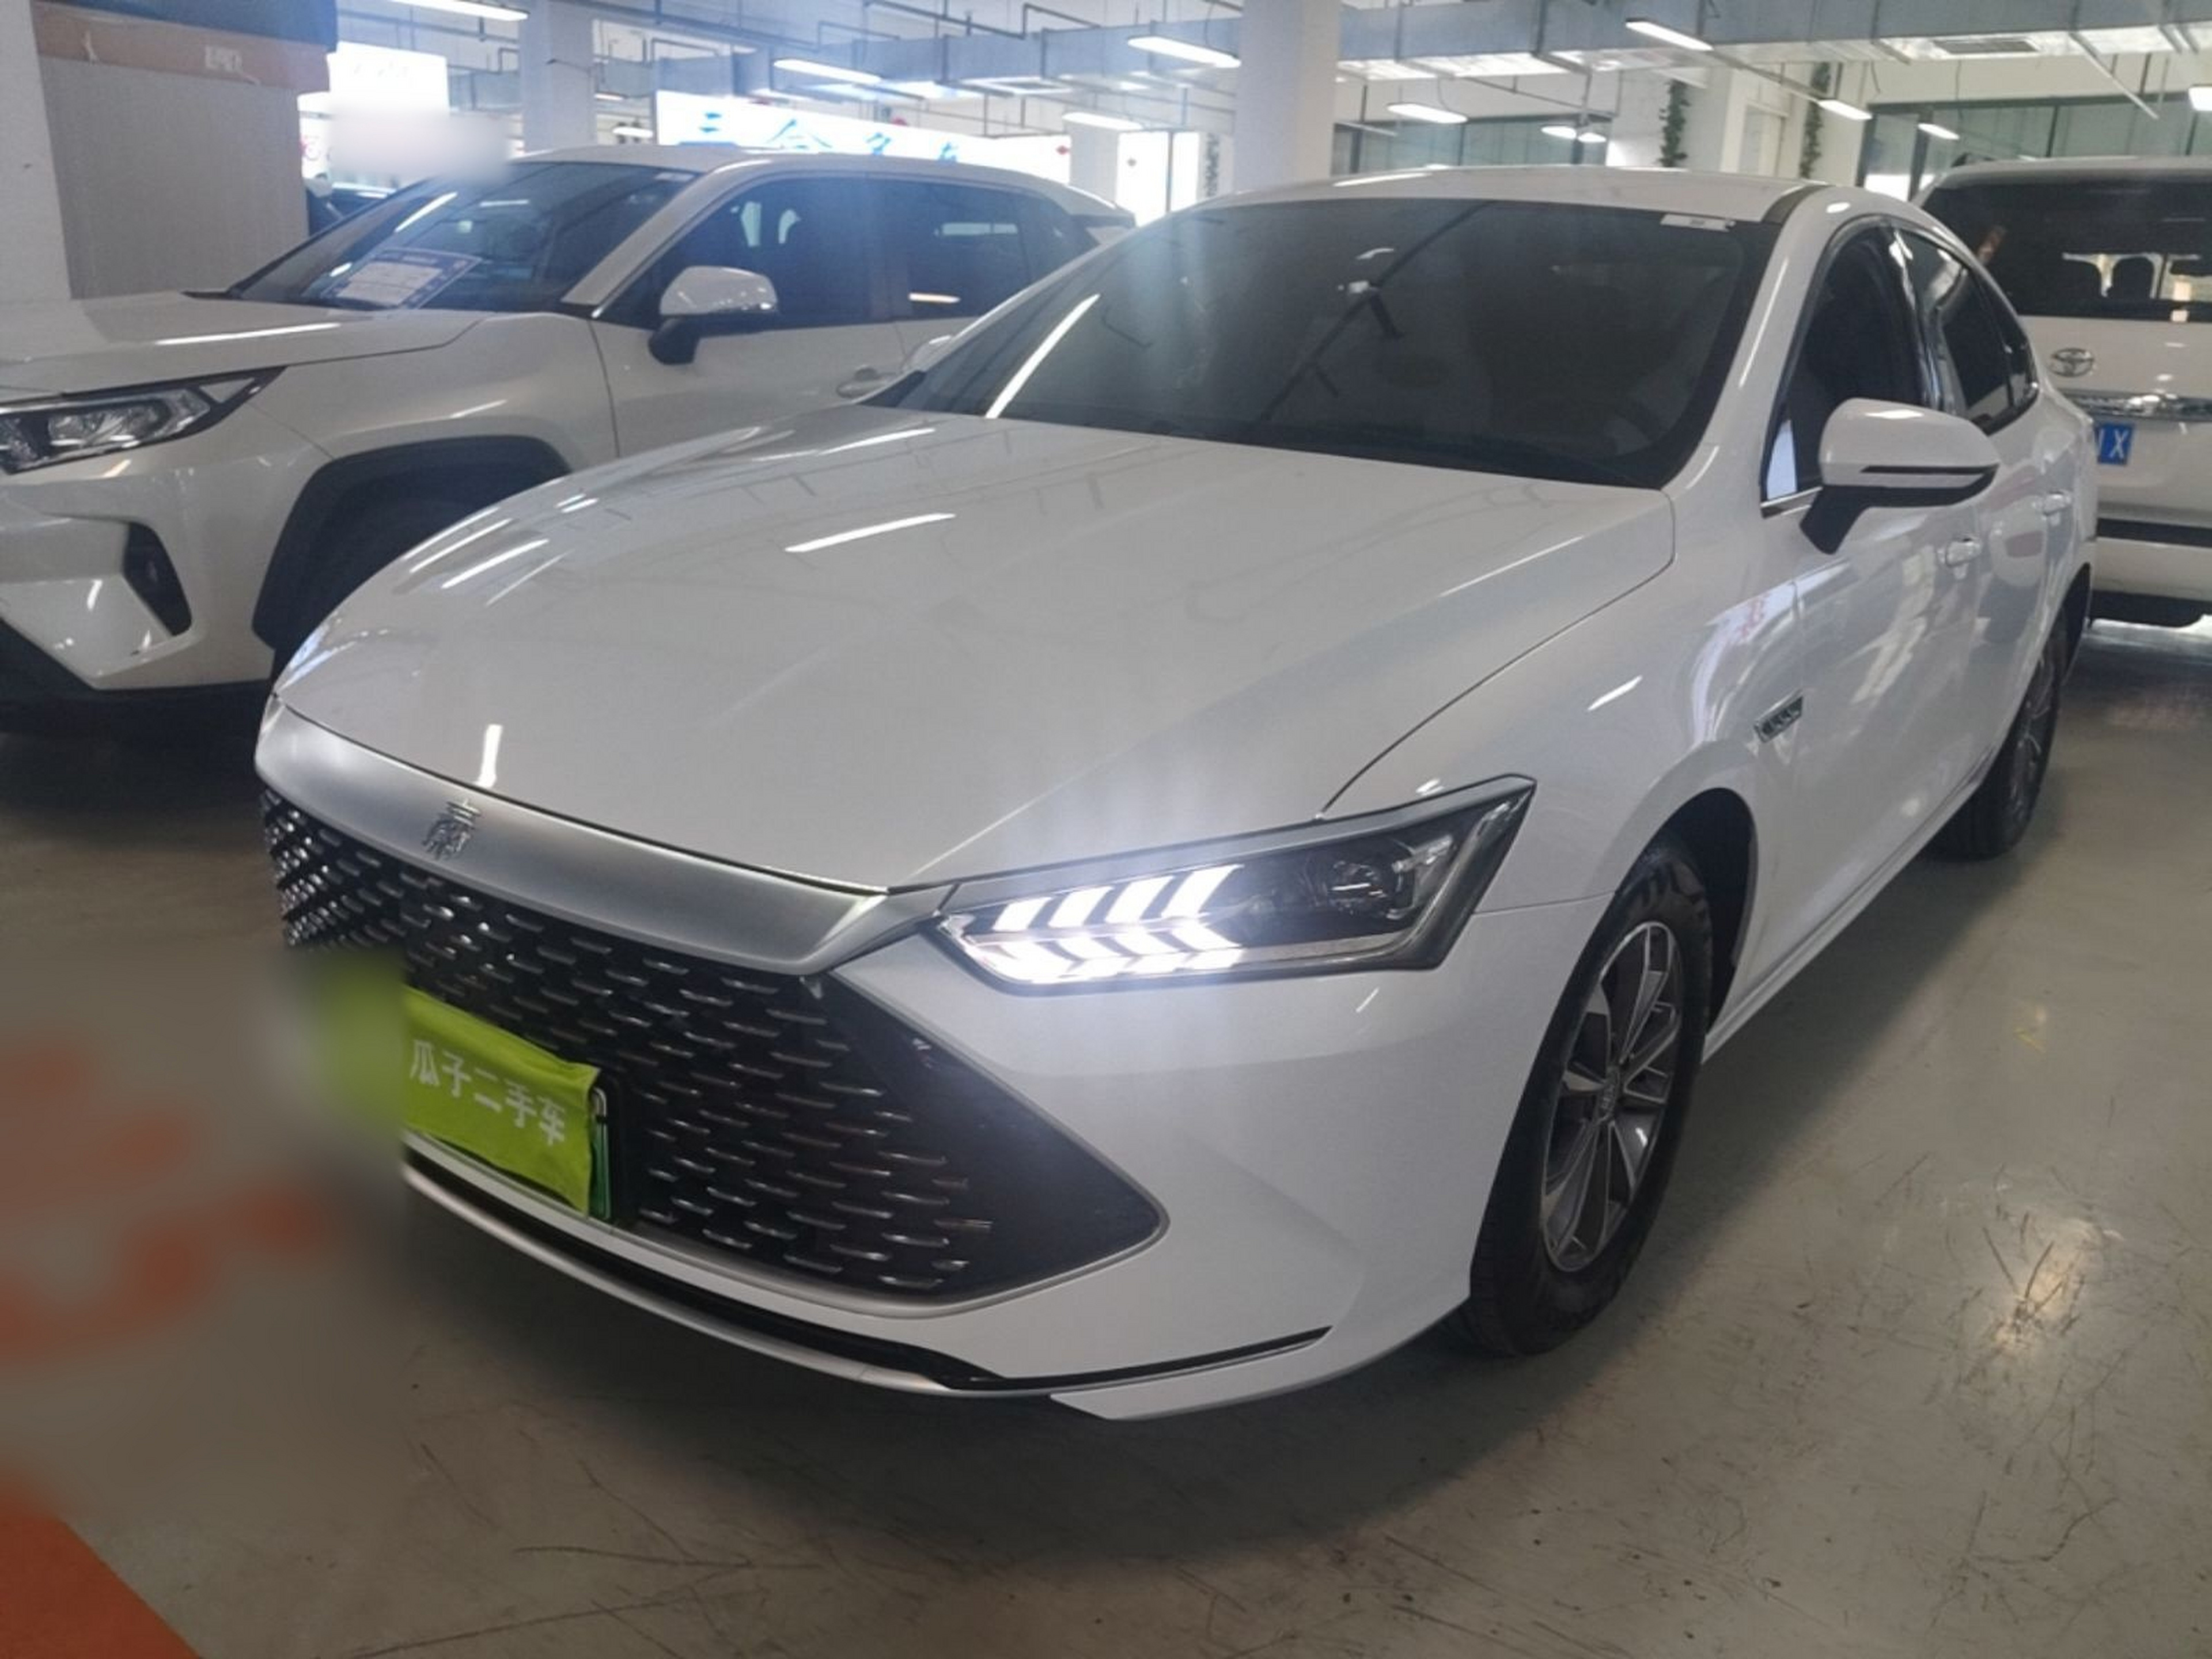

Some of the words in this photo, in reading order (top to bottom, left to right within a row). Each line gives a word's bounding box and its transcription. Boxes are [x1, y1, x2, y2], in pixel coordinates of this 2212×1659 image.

[408, 1039, 565, 1146] 瓜子二手车
